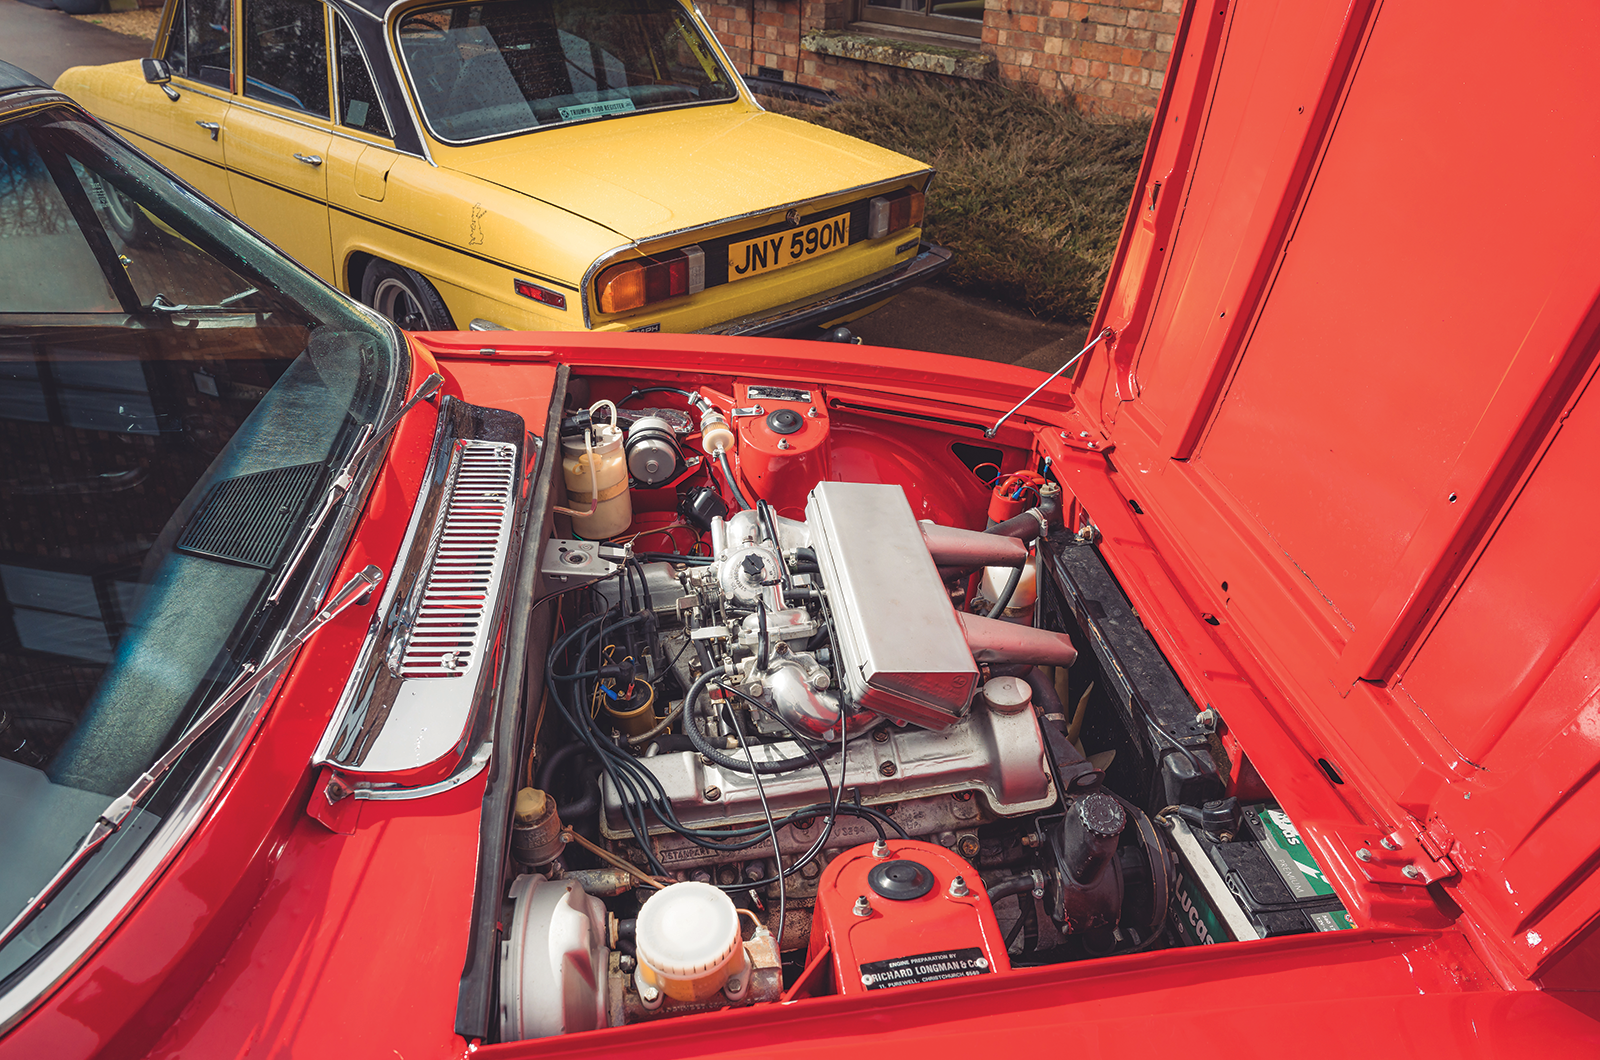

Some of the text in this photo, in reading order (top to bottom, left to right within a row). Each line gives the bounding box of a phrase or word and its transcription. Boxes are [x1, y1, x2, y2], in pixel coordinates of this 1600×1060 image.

[570, 102, 625, 116] TRIUMPH 2000 REGISTER
[735, 218, 846, 275] JNY 590N
[1277, 858, 1305, 893] PREMIUM
[1175, 872, 1215, 945] Lucas
[871, 968, 913, 983] RICHARD
[914, 961, 960, 976] LONGMAN
[959, 960, 967, 969] &
[888, 960, 910, 968] ENGINE
[910, 955, 948, 965] PREPARATION
